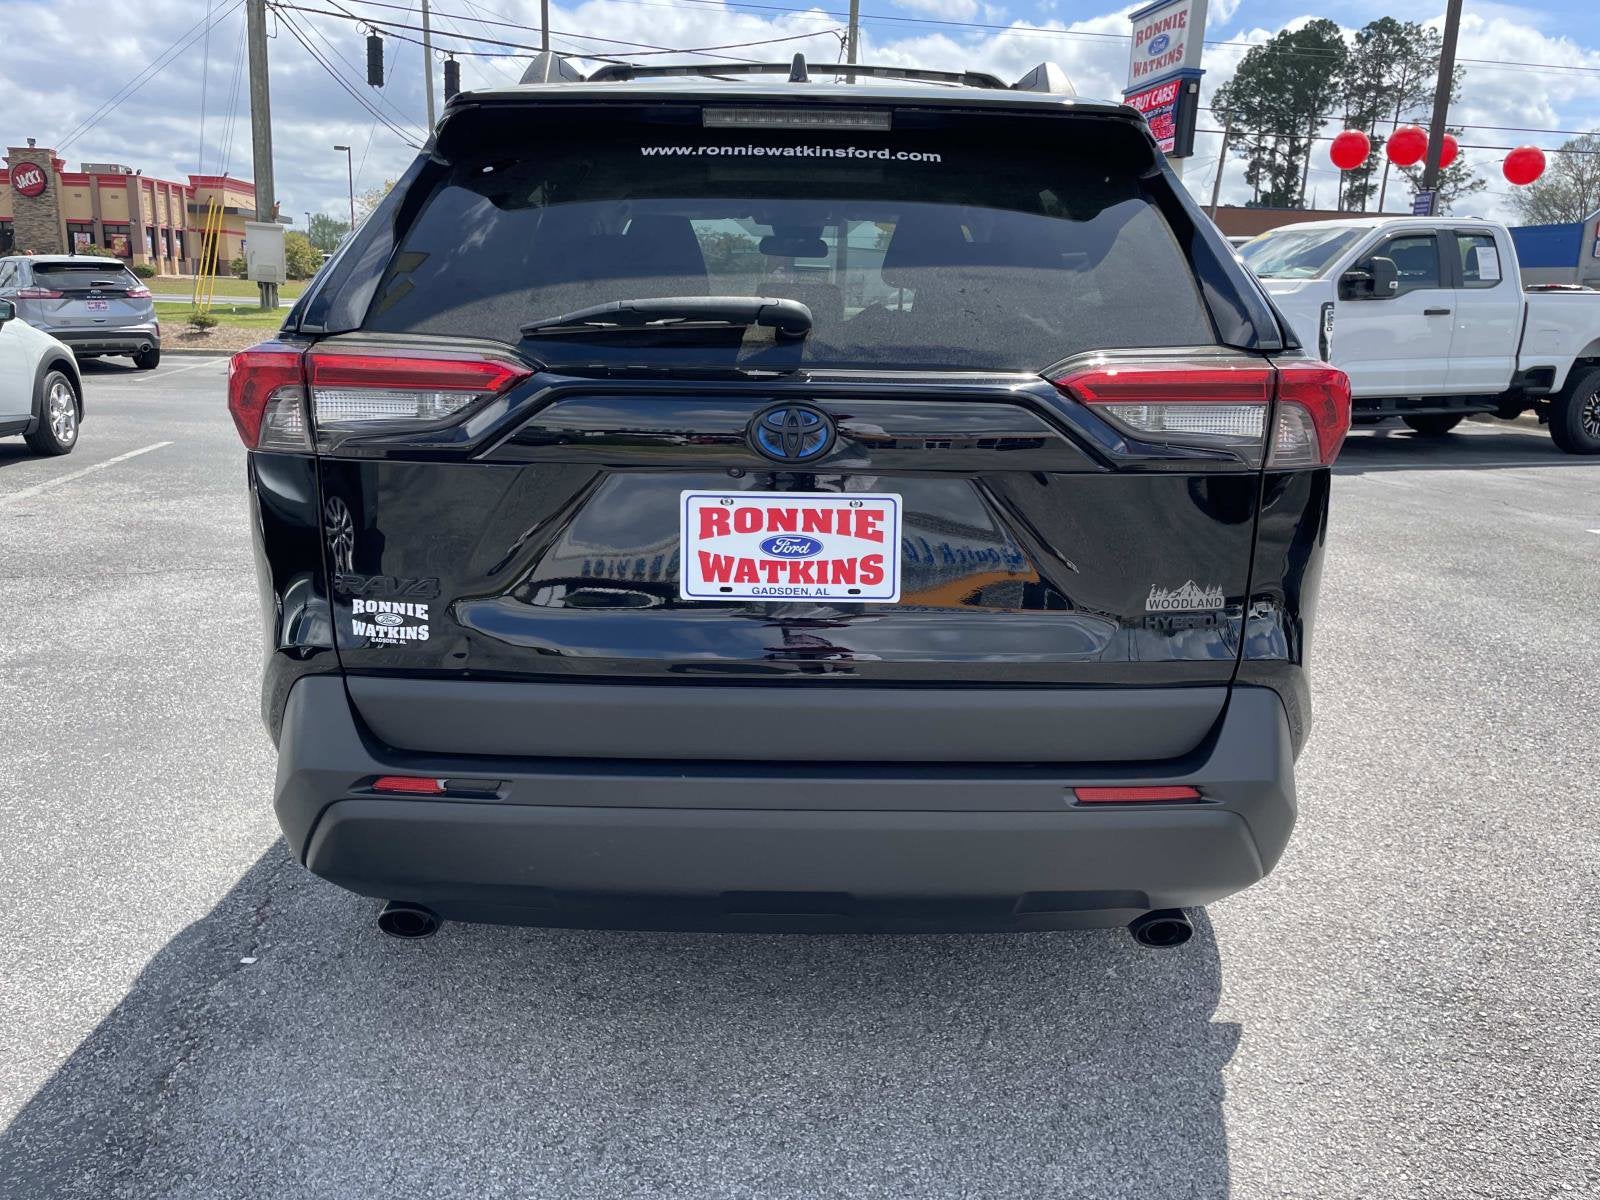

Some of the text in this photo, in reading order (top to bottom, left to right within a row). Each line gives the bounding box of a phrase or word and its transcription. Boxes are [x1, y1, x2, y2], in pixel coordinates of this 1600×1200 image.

[1136, 10, 1187, 48] RONNIE
[1133, 43, 1184, 78] WATKINS
[1135, 93, 1151, 111] BUY
[1151, 83, 1177, 106] CARS!
[641, 144, 942, 163] www.ronniewatkinsford.com
[699, 507, 885, 543] RONNIE
[772, 538, 811, 554] Ford
[698, 550, 885, 586] WATKINS
[335, 575, 440, 599] RAV4
[751, 586, 830, 596] GADSDEN, AL
[352, 599, 429, 620] RONNIE
[1149, 598, 1222, 609] WOODLAND
[352, 619, 430, 641] WATKINS
